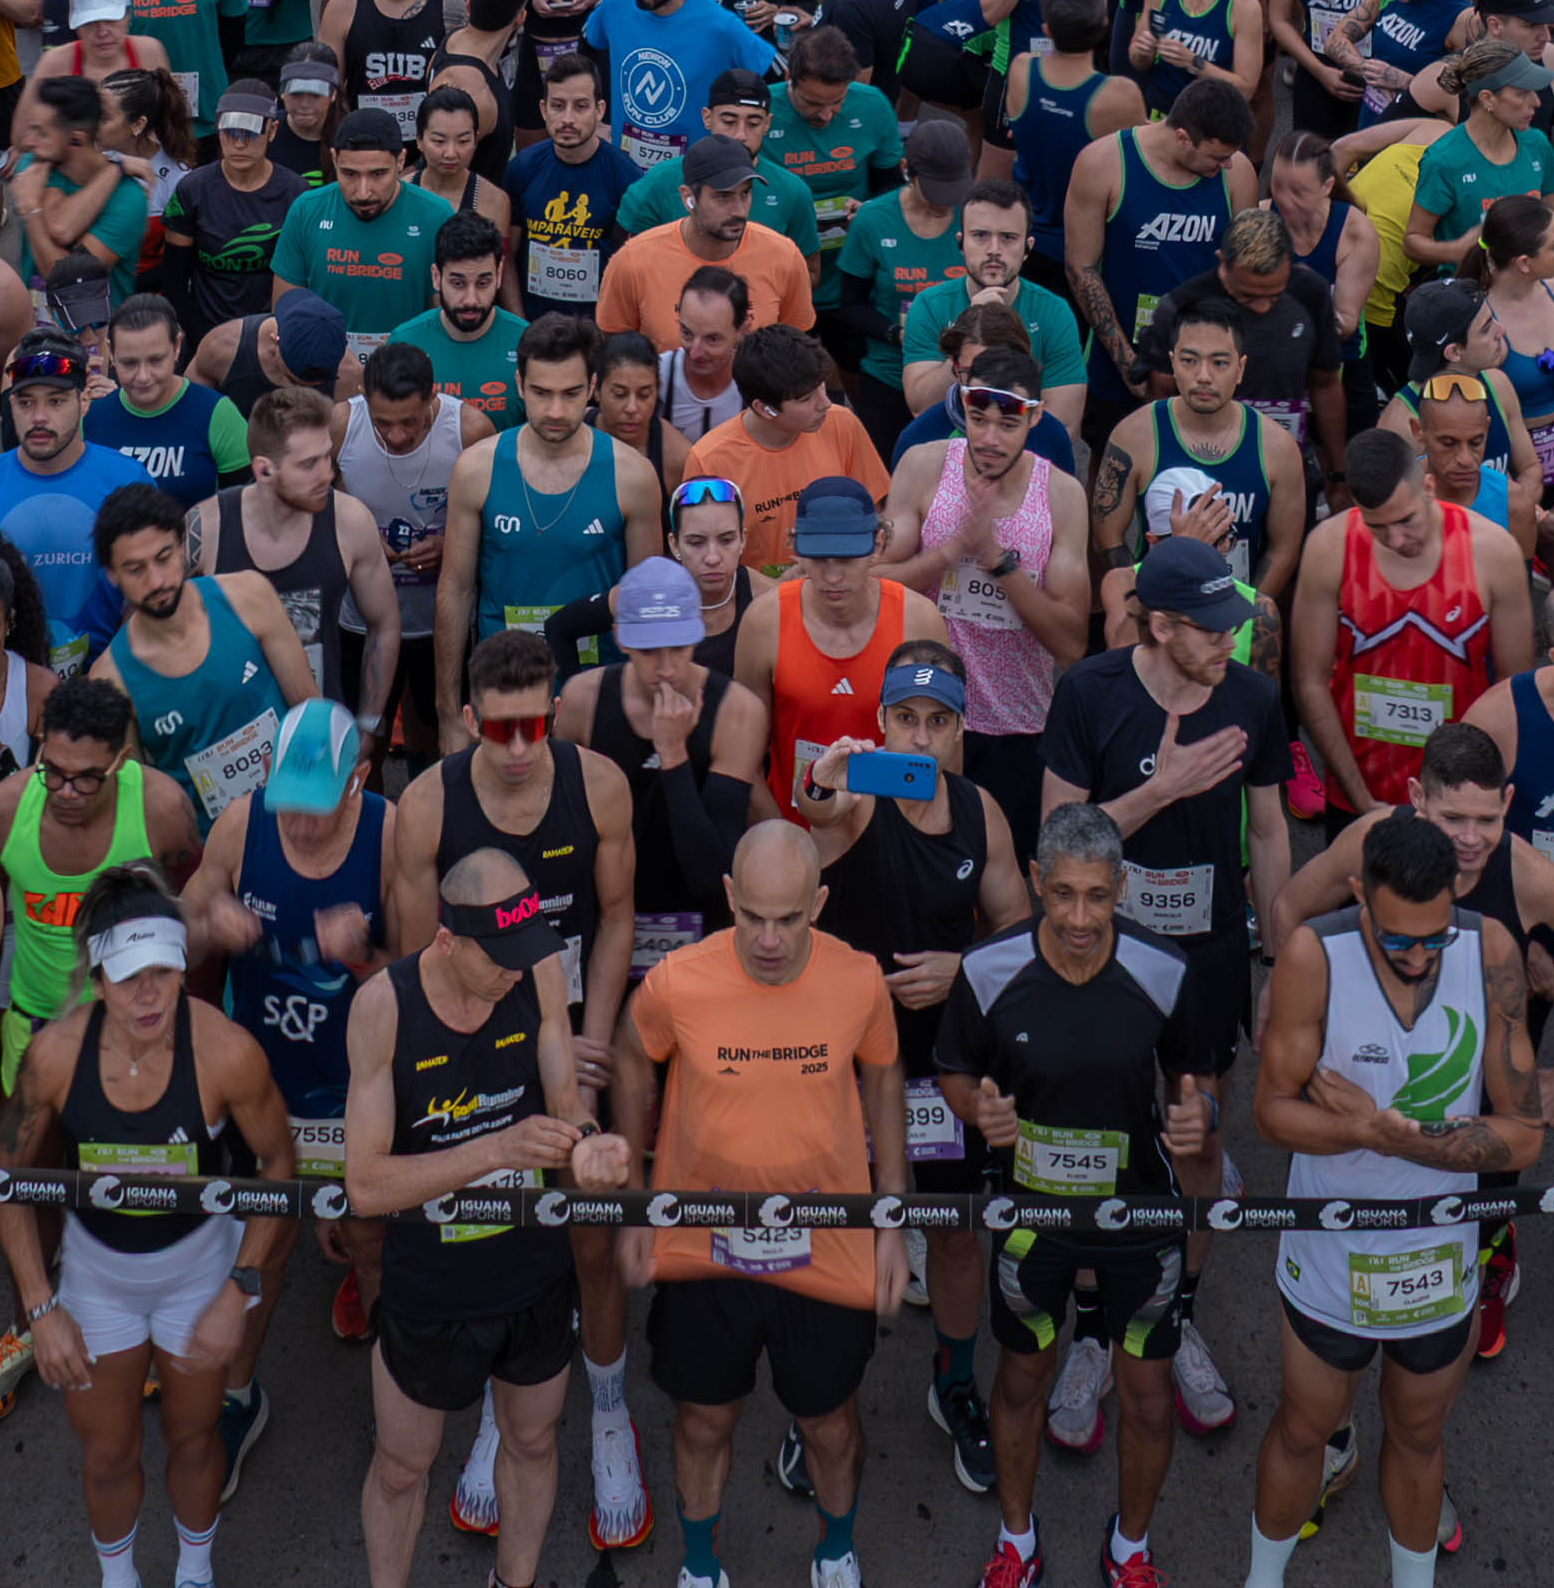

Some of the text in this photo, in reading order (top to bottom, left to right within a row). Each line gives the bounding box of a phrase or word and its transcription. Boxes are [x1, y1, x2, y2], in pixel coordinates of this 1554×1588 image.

[149, 3, 197, 18] BRIDGE
[1376, 12, 1426, 52] AZON
[365, 52, 427, 80] SUB
[644, 105, 678, 124] CLUB
[783, 151, 815, 165] RUN
[804, 159, 857, 176] BRIDGE
[1136, 212, 1215, 244] AZON
[326, 248, 359, 263] RUN
[326, 263, 402, 281] THE BRIDGE
[546, 266, 588, 282] 8060
[894, 267, 927, 281] RUN
[33, 553, 93, 567] ZURICH
[1385, 702, 1433, 723] 7313
[222, 741, 274, 780] 8083
[1140, 891, 1196, 909] 9356
[263, 996, 329, 1042] S&P
[801, 1062, 829, 1075] 2025
[291, 1125, 345, 1144] 7558
[1052, 1129, 1074, 1140] RUN
[1047, 1152, 1109, 1171] 7545
[15, 1183, 66, 1194] IGUANA
[126, 1188, 176, 1200] IGUANA
[237, 1192, 288, 1204] IGUANA
[460, 1200, 511, 1212] IGUANA
[572, 1203, 623, 1215] IGUANA
[684, 1204, 735, 1216] IGUANA
[795, 1207, 846, 1218] IGUANA
[1467, 1199, 1518, 1213] IGUANA
[908, 1208, 958, 1219] IGUANA
[1020, 1209, 1071, 1220] IGUANA
[1132, 1209, 1183, 1220] IGUANA
[1244, 1209, 1295, 1220] IGUANA
[1356, 1209, 1407, 1220] IGUANA
[1388, 1253, 1410, 1264] RUN
[1402, 1252, 1437, 1270] BRIDGE
[1387, 1270, 1445, 1297] 7543
